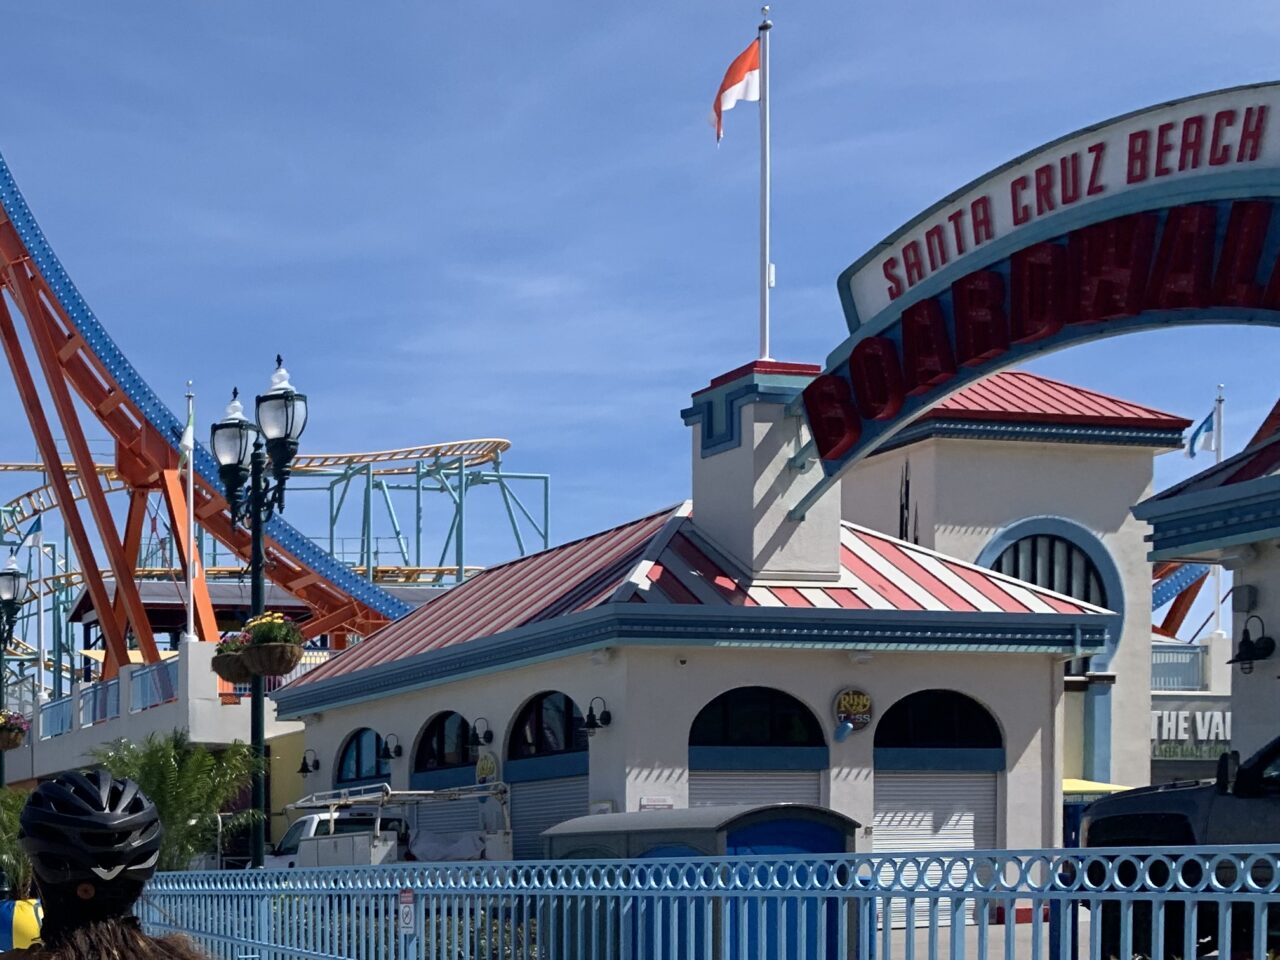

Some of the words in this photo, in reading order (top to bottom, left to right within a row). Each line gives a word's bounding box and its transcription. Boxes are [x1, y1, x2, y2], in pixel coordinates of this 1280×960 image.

[881, 195, 994, 301] SANTA
[1010, 141, 1106, 226] CRUZ
[1126, 104, 1269, 186] BEACH
[802, 199, 1280, 460] BOARDWAL
[1151, 711, 1190, 740] THE
